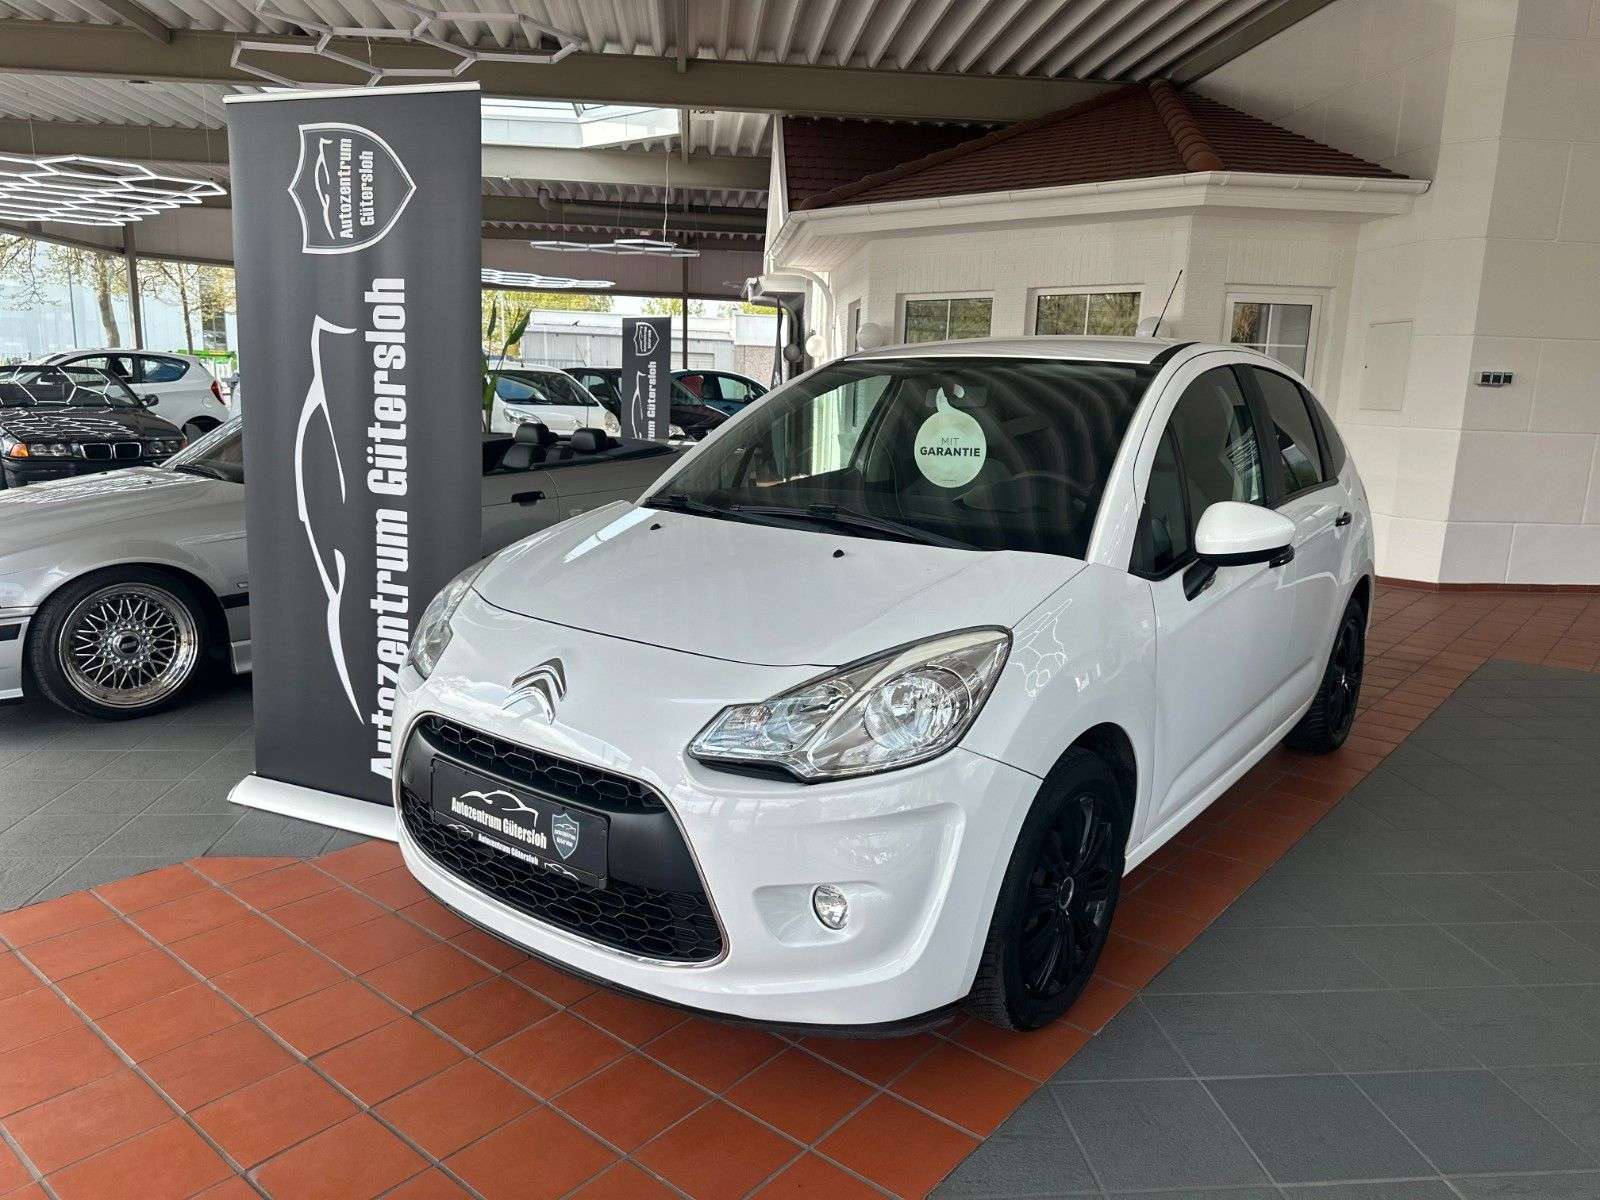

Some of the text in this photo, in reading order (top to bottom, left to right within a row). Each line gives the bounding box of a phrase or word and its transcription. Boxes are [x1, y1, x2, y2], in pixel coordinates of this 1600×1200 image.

[338, 138, 353, 239] Autozentrum
[359, 151, 374, 226] Gütersloh
[364, 278, 407, 496] Gütersloh
[920, 446, 981, 457] GARANTIE
[941, 437, 960, 446] MIT
[451, 797, 502, 832] Autozentrum
[503, 817, 547, 850] Gütersloh
